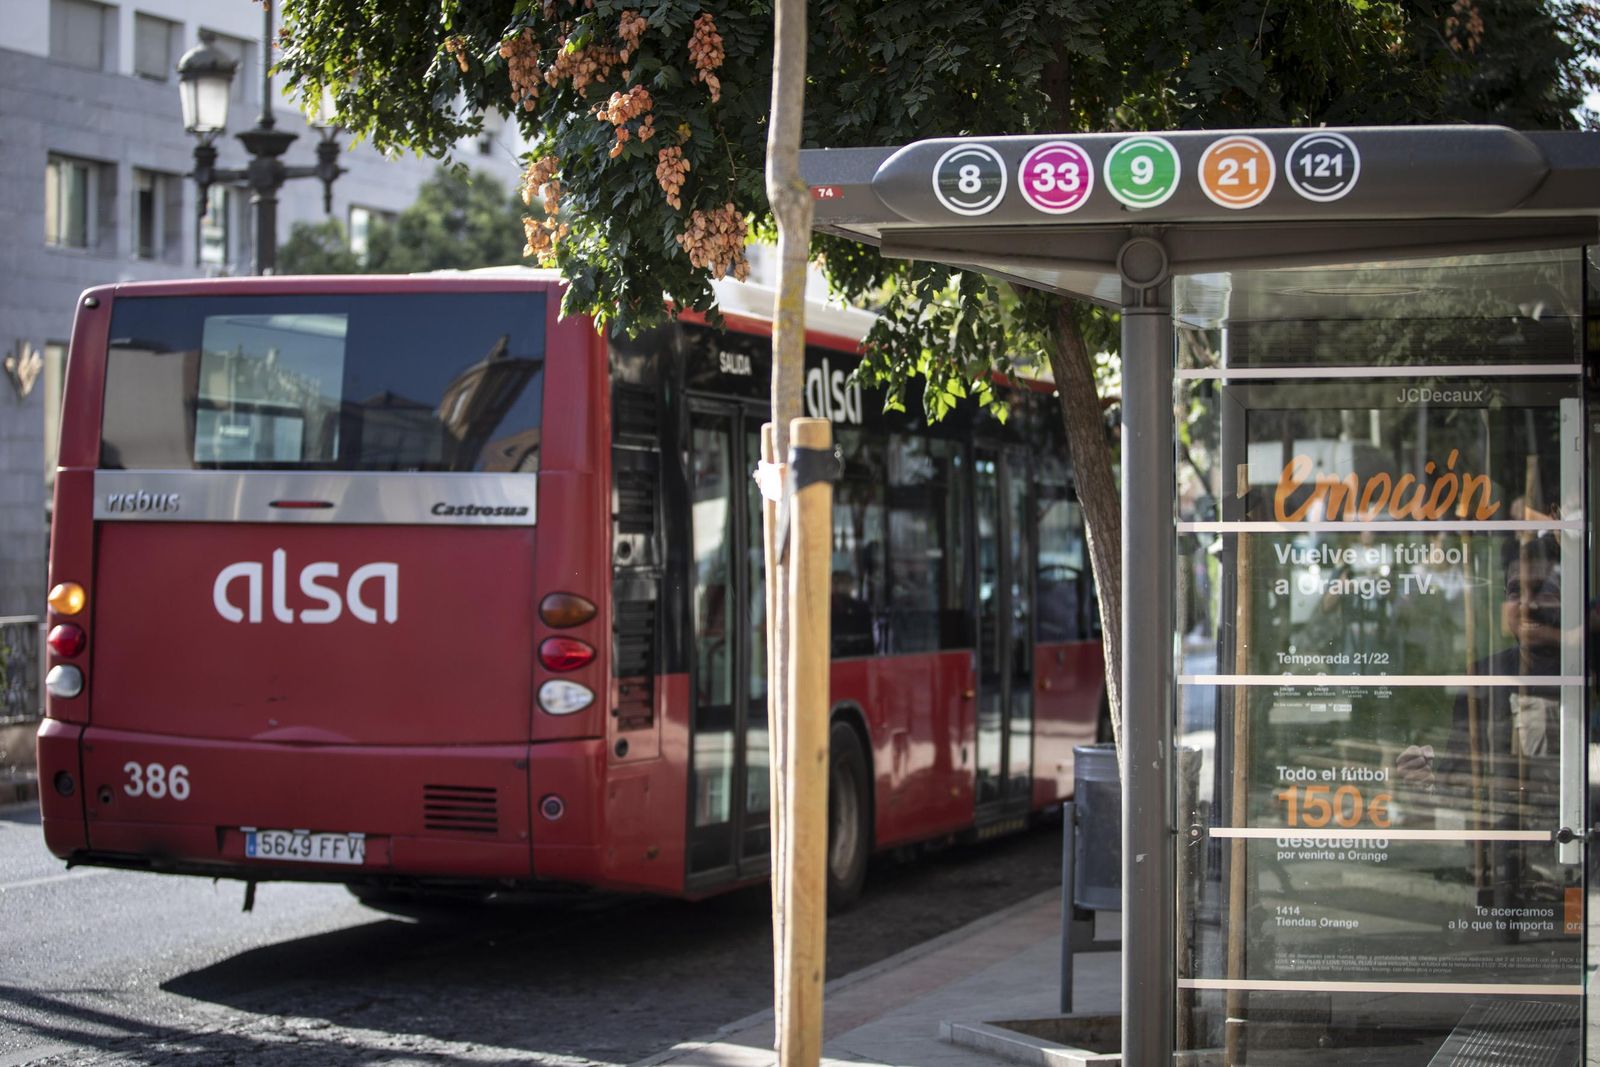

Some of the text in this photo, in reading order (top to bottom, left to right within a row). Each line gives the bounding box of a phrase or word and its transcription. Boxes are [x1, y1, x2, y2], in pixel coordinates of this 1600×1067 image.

[1130, 155, 1153, 185] 9
[1216, 157, 1259, 186] 21
[1299, 153, 1344, 177] 121
[957, 165, 982, 195] 8
[1032, 163, 1080, 193] 33
[817, 187, 835, 198] 74
[719, 352, 752, 375] SALIDA
[807, 357, 862, 424] alsa
[1397, 387, 1483, 403] JCDecaux
[430, 502, 530, 518] Castrosua
[1274, 543, 1468, 566] Vuelve el fútbol
[213, 547, 399, 624] alsa
[1274, 574, 1436, 600] a Orange TV.
[1277, 652, 1389, 666] Temporada 21/22
[123, 761, 191, 801] 386
[1276, 766, 1389, 780] Todo el fútbol
[262, 833, 360, 860] 5649 FFV
[1276, 837, 1390, 849] descuento
[1277, 850, 1388, 862] por venirte a Orange
[1275, 906, 1301, 916] 1414
[1475, 905, 1554, 917] Te acercamos
[1275, 917, 1359, 929] Tiendas Orange
[1448, 919, 1555, 932] a lo que te importa
